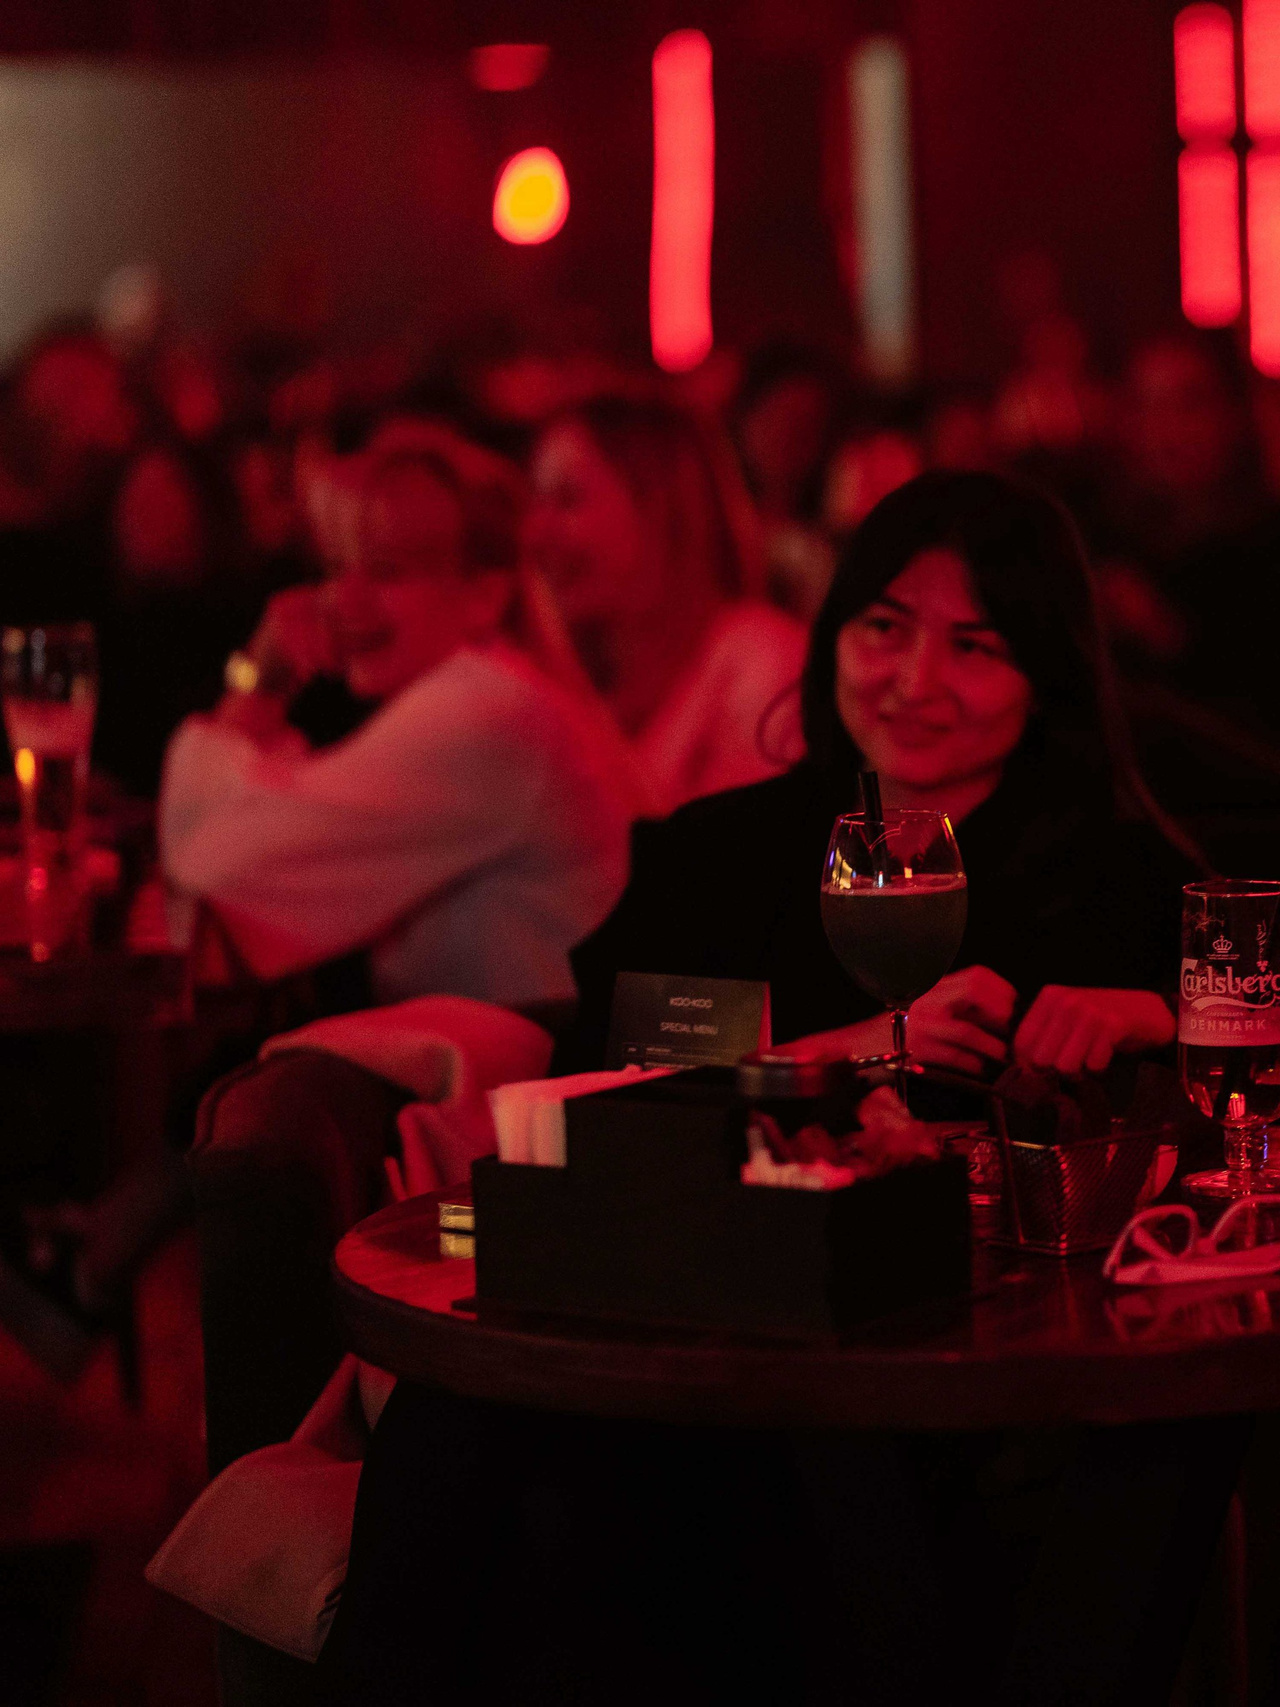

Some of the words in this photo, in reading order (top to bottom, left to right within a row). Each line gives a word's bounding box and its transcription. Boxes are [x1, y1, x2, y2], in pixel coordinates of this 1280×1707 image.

[660, 1022, 692, 1032] SPECIAL
[693, 1024, 718, 1035] MENU
[1190, 1018, 1267, 1031] DENMARK
